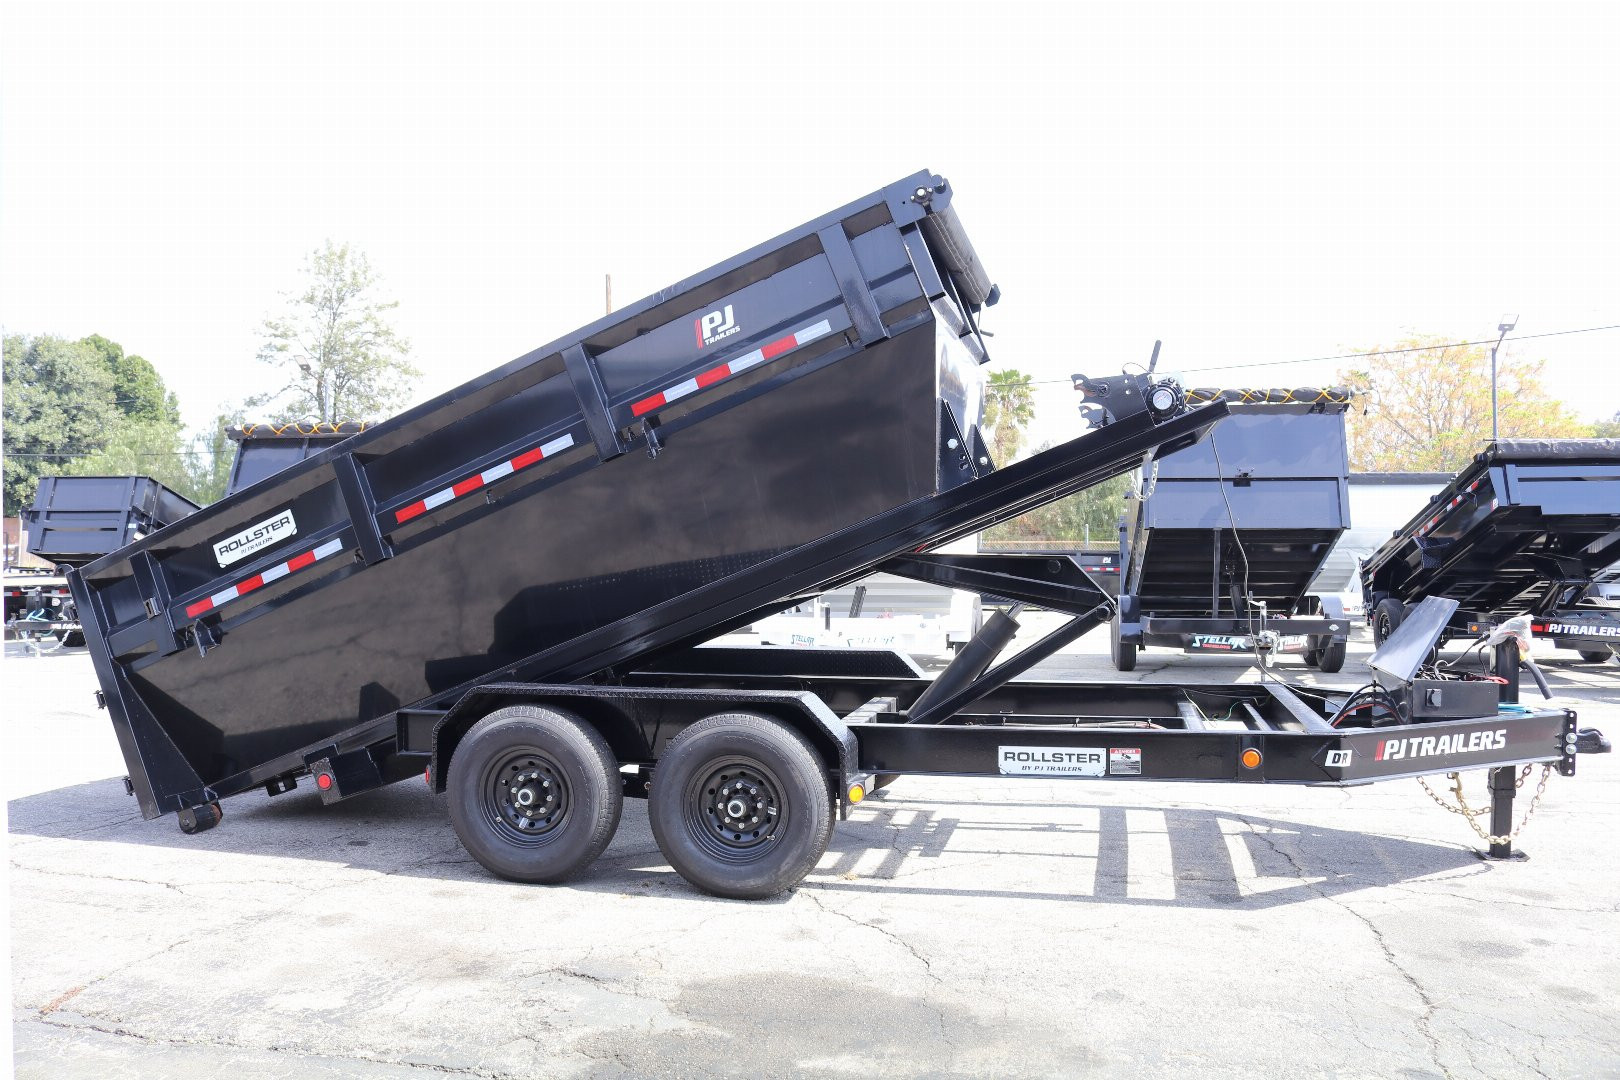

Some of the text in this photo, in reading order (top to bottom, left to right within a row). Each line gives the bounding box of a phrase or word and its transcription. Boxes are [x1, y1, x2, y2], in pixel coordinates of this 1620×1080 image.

[701, 304, 735, 340] PJ
[704, 325, 741, 346] TRAILERS
[218, 516, 291, 556] ROLLSTER
[1548, 623, 1562, 633] PJ
[1192, 635, 1247, 650] STELLAR
[1383, 729, 1507, 760] PJ TRAILERS
[1003, 751, 1101, 764] ROLLSTER
[1331, 752, 1348, 765] DR
